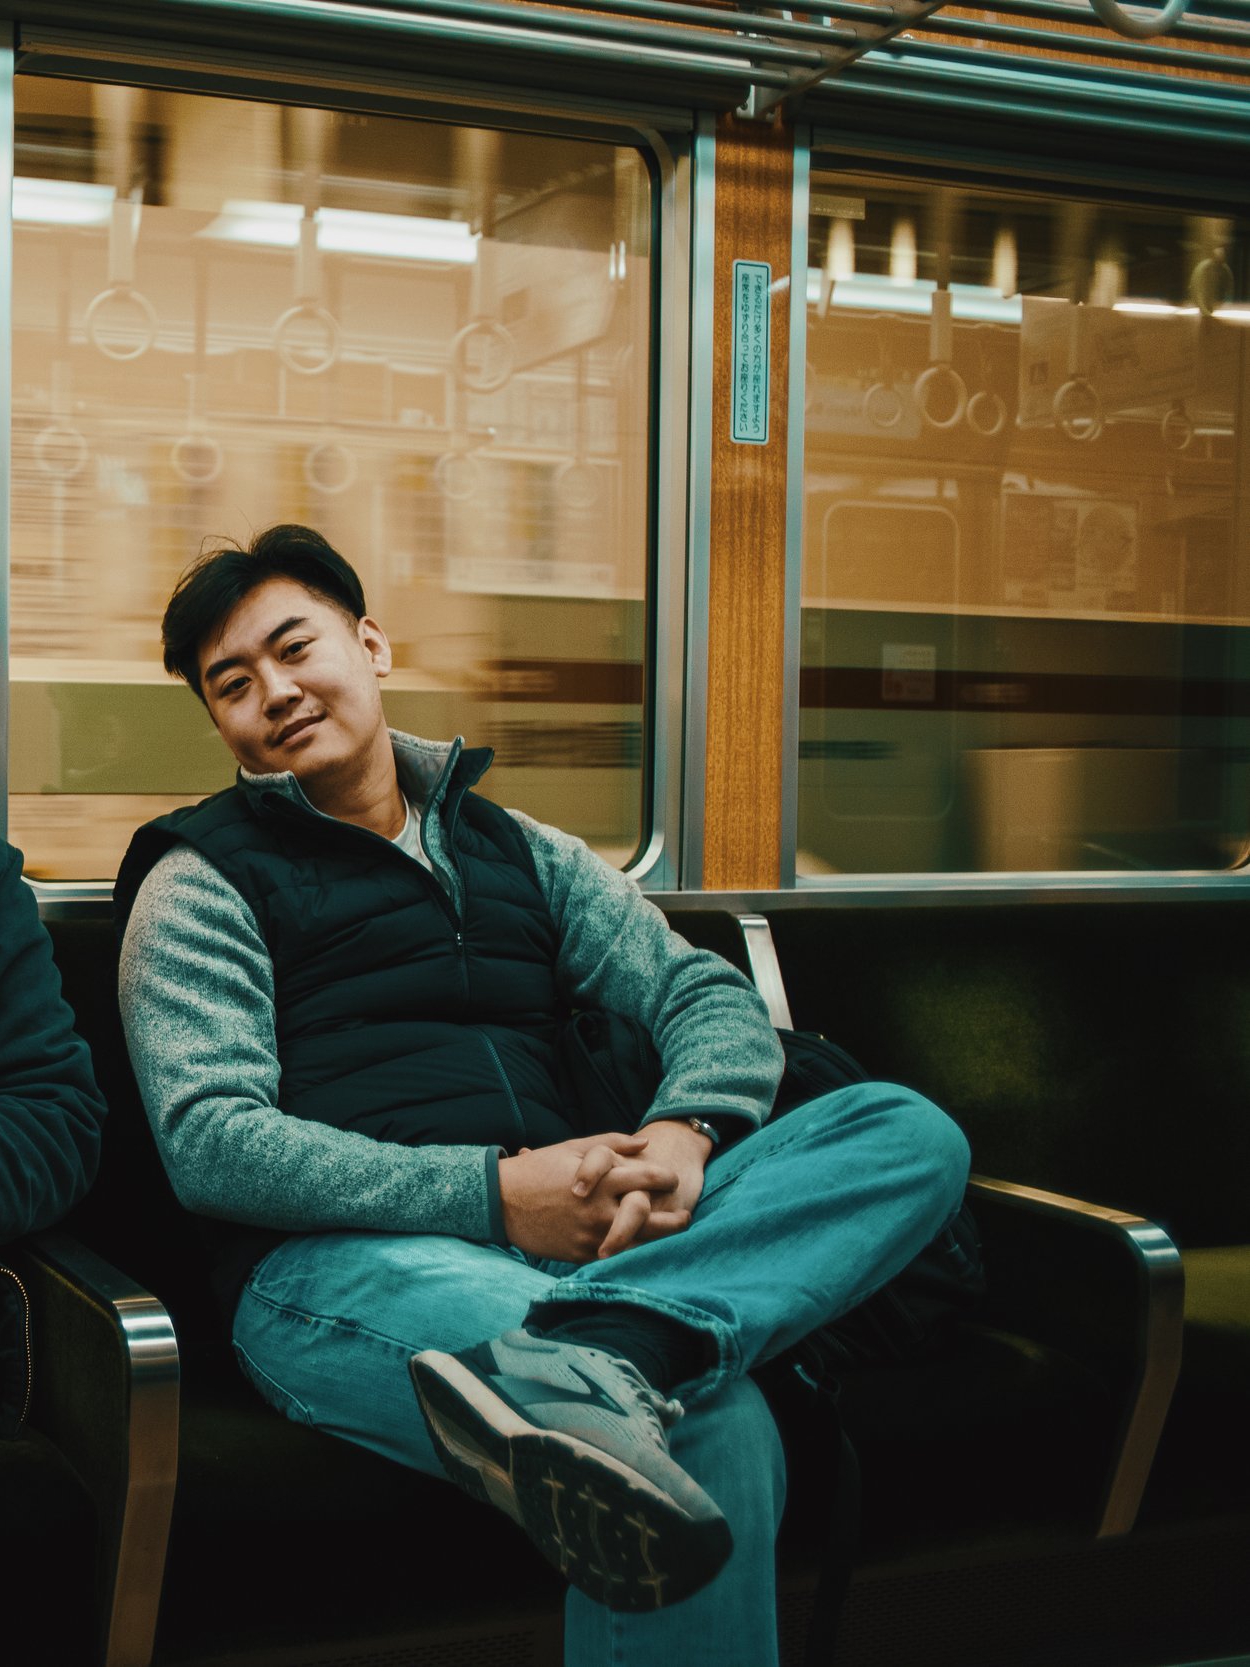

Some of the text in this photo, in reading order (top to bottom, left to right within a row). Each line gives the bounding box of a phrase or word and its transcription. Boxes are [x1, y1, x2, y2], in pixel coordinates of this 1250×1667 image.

[739, 272, 750, 432] 座席をゆずり合ってお座りください
[752, 274, 763, 434] できるだけ多くの方が座れますよう
